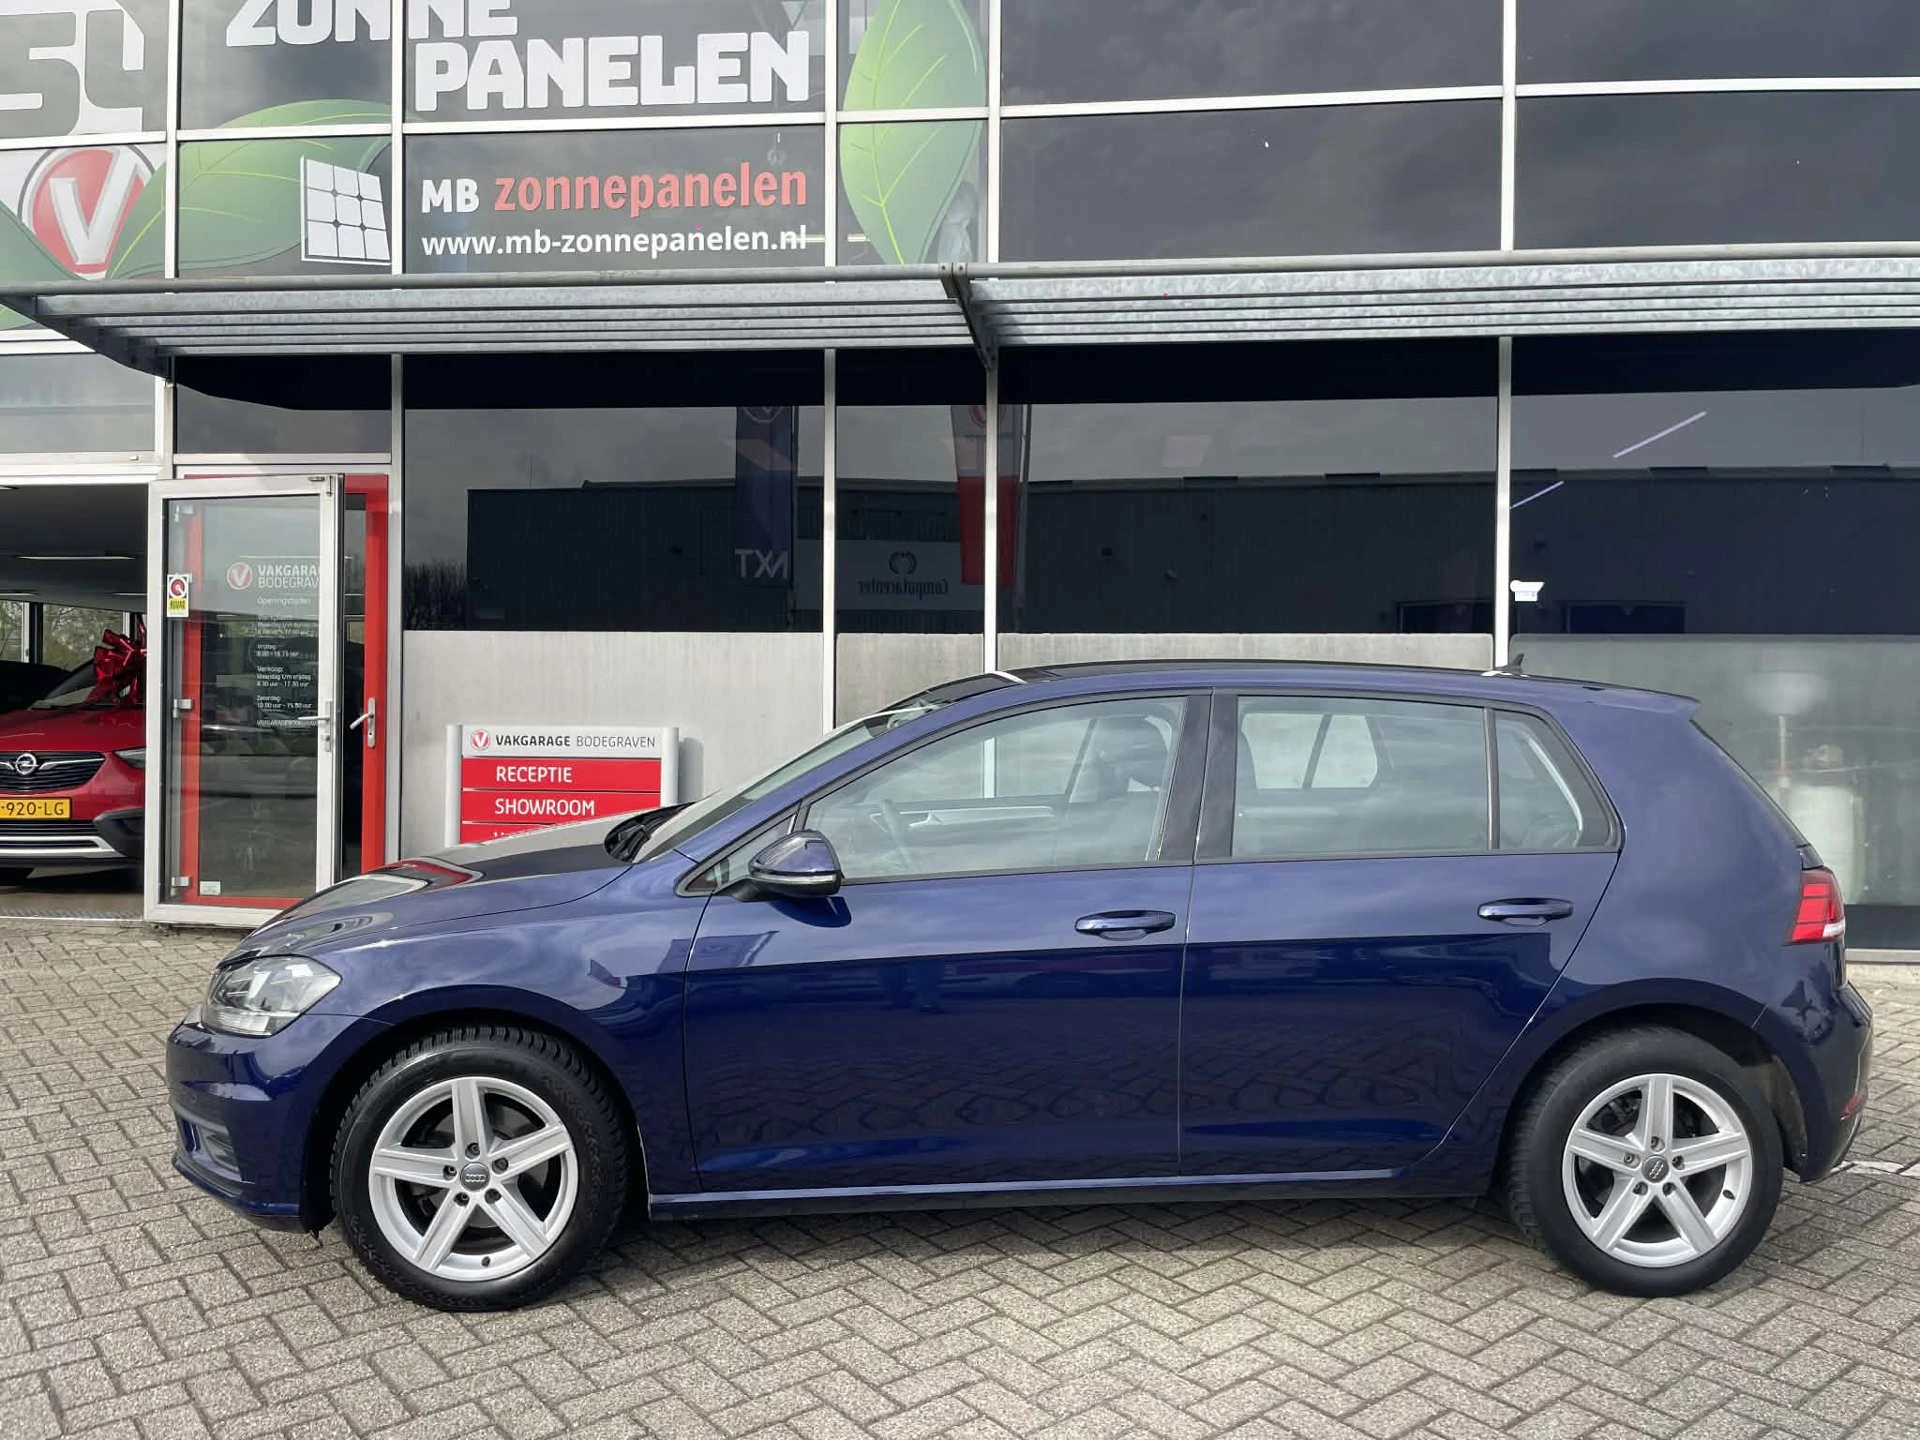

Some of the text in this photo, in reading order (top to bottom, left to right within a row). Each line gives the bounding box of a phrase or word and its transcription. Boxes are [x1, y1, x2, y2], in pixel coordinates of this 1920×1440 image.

[415, 31, 810, 112] PANELEN
[421, 162, 808, 217] MB zonnepanelen
[422, 225, 807, 259] www.mb-zonnepanelen.nl
[258, 564, 320, 577] VAKGARA
[495, 735, 570, 747] VAKGARAGE
[576, 735, 656, 748] BODEGRAVEN
[496, 766, 573, 783] RECEPTIE
[495, 798, 596, 816] SHOWROOM
